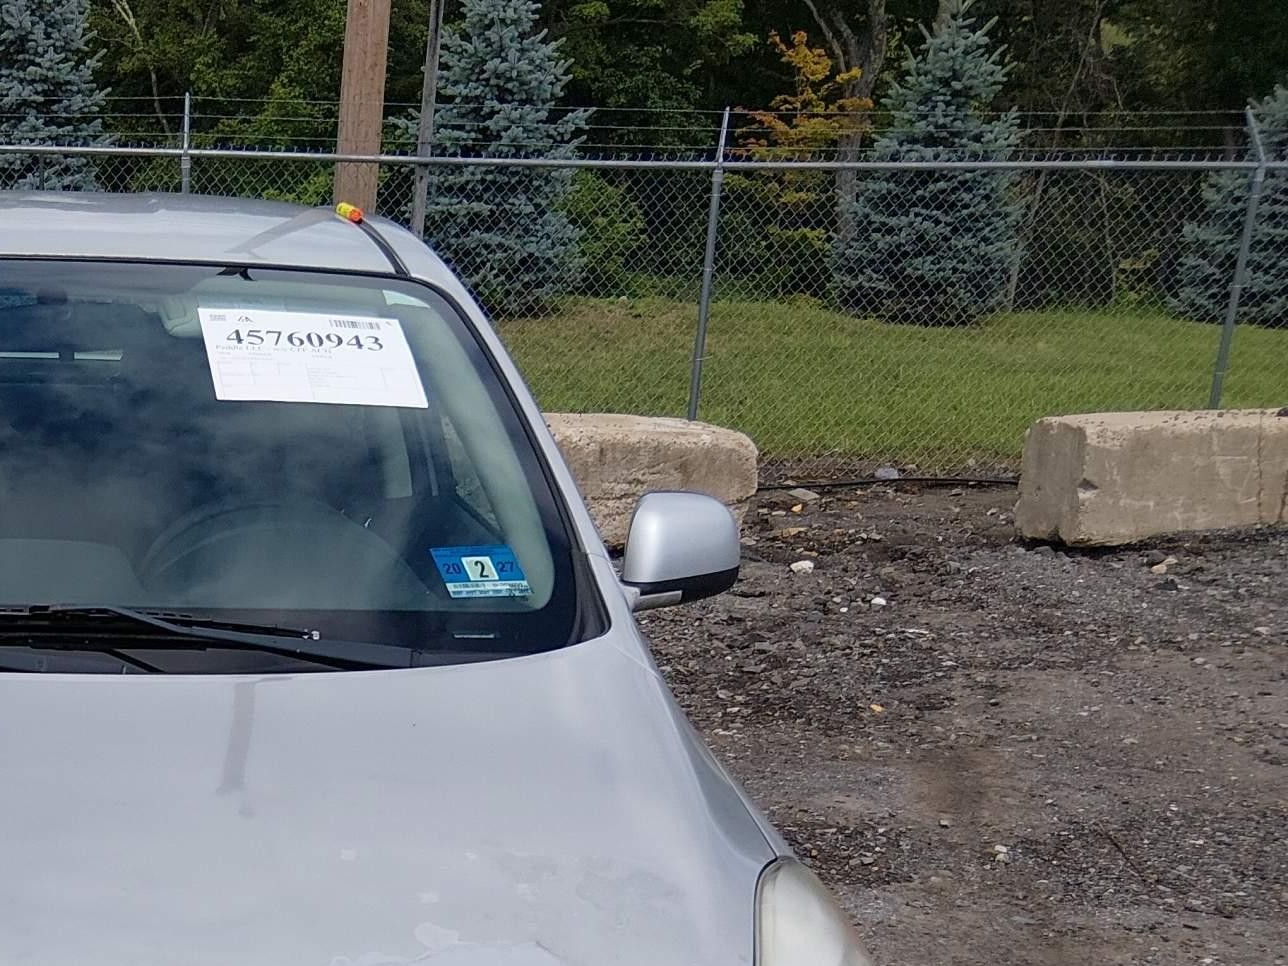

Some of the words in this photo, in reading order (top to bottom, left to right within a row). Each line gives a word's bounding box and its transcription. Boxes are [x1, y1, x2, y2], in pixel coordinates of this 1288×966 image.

[226, 328, 384, 352] 45760943
[443, 562, 462, 575] 20
[473, 560, 489, 578] 2
[496, 561, 514, 573] 27
